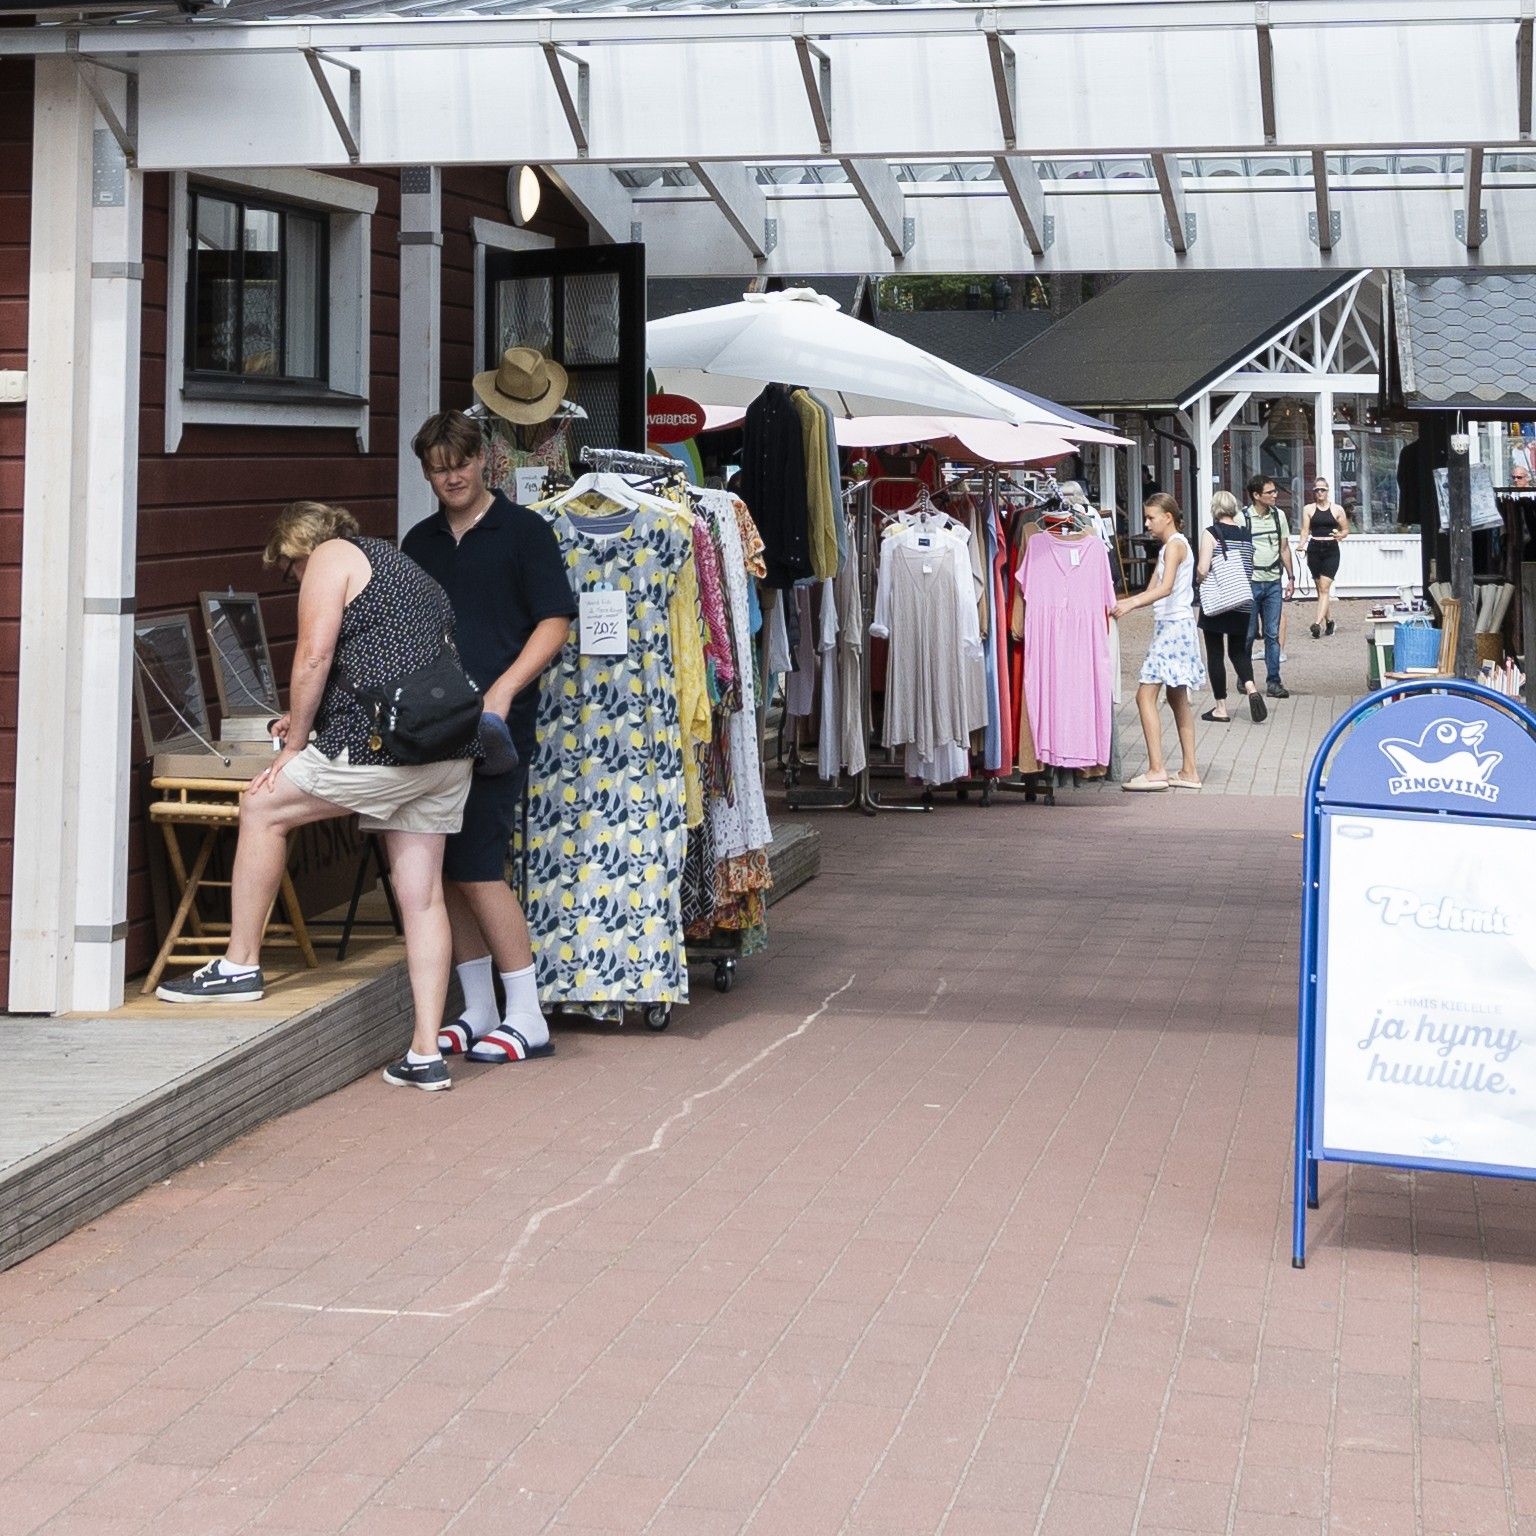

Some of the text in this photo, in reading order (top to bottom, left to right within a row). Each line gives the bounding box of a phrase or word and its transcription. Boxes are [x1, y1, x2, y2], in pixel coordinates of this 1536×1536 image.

[647, 413, 698, 426] vaianas
[1391, 778, 1497, 799] PINGVIINI
[1365, 885, 1515, 935] Pehmis
[1357, 1008, 1523, 1063] ja hymy
[1366, 1053, 1517, 1095] huulille.
